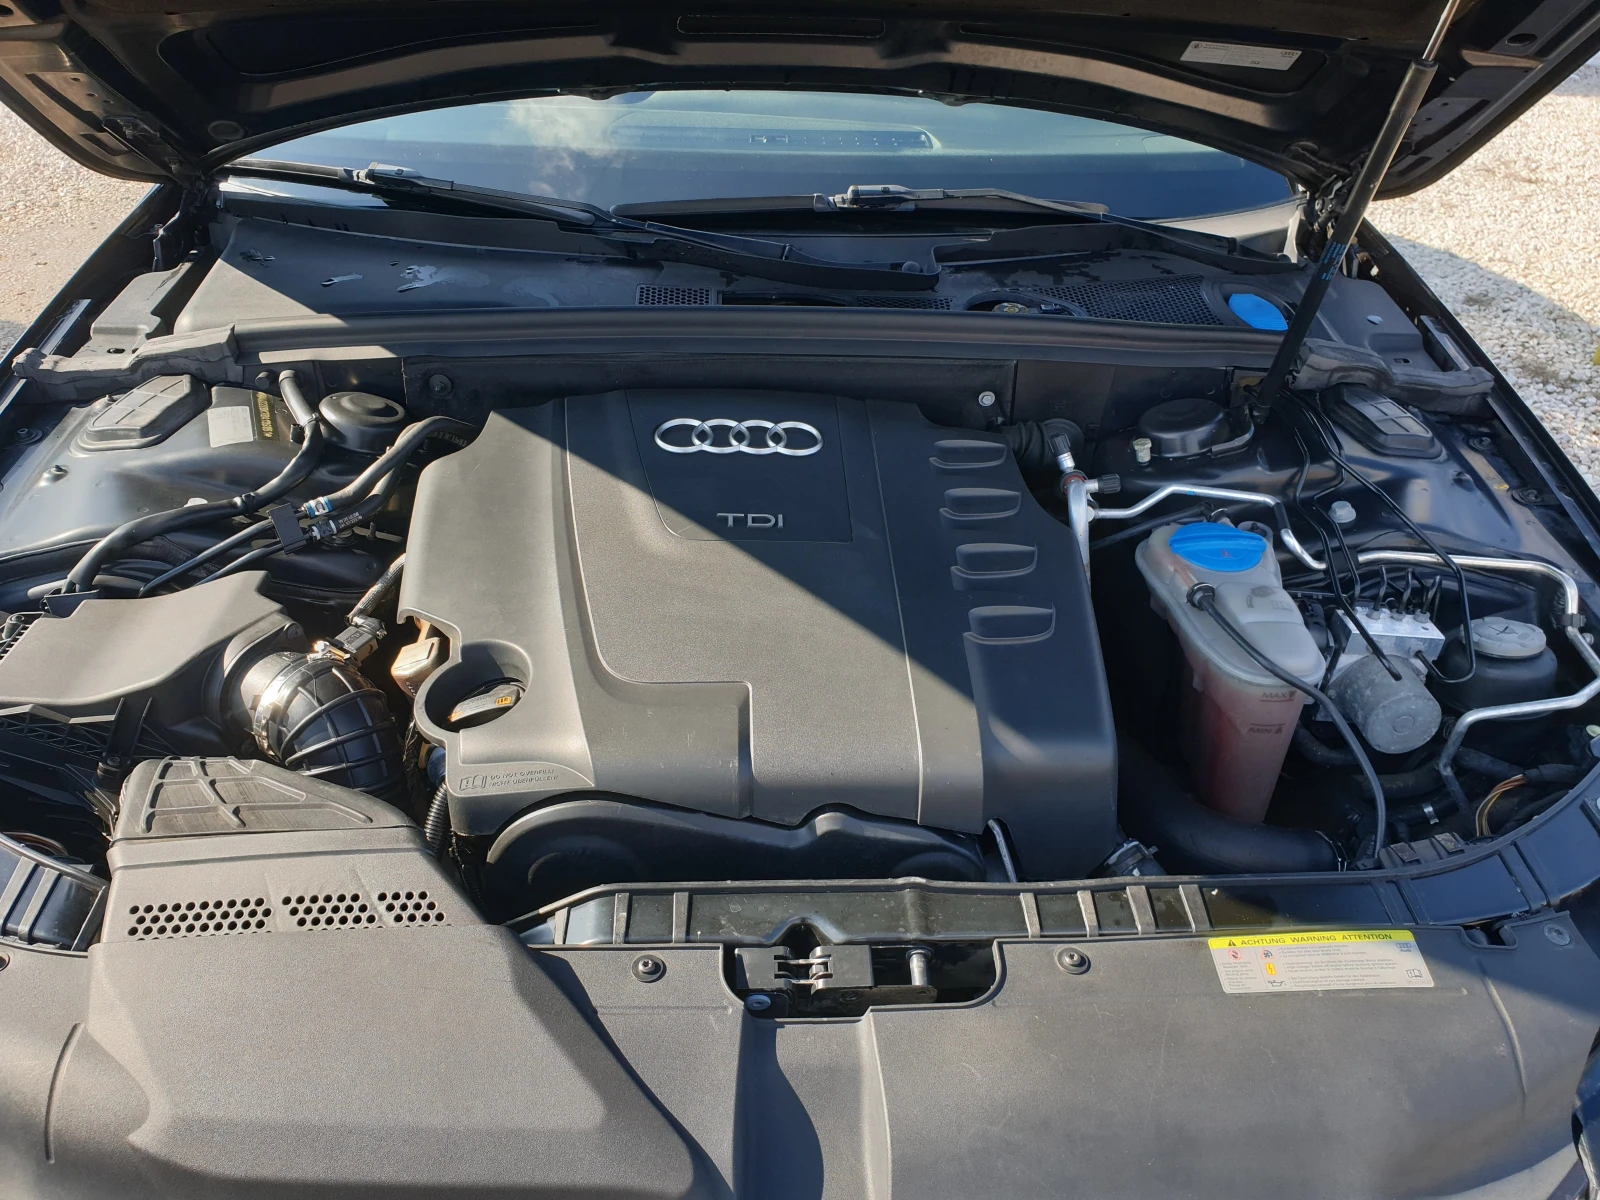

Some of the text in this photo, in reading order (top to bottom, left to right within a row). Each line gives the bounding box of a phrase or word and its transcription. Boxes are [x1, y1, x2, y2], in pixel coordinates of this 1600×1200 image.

[716, 512, 784, 529] TDI
[1262, 691, 1287, 699] MAX
[1240, 933, 1392, 946] ACHTUNG WARNING ATTENTION
